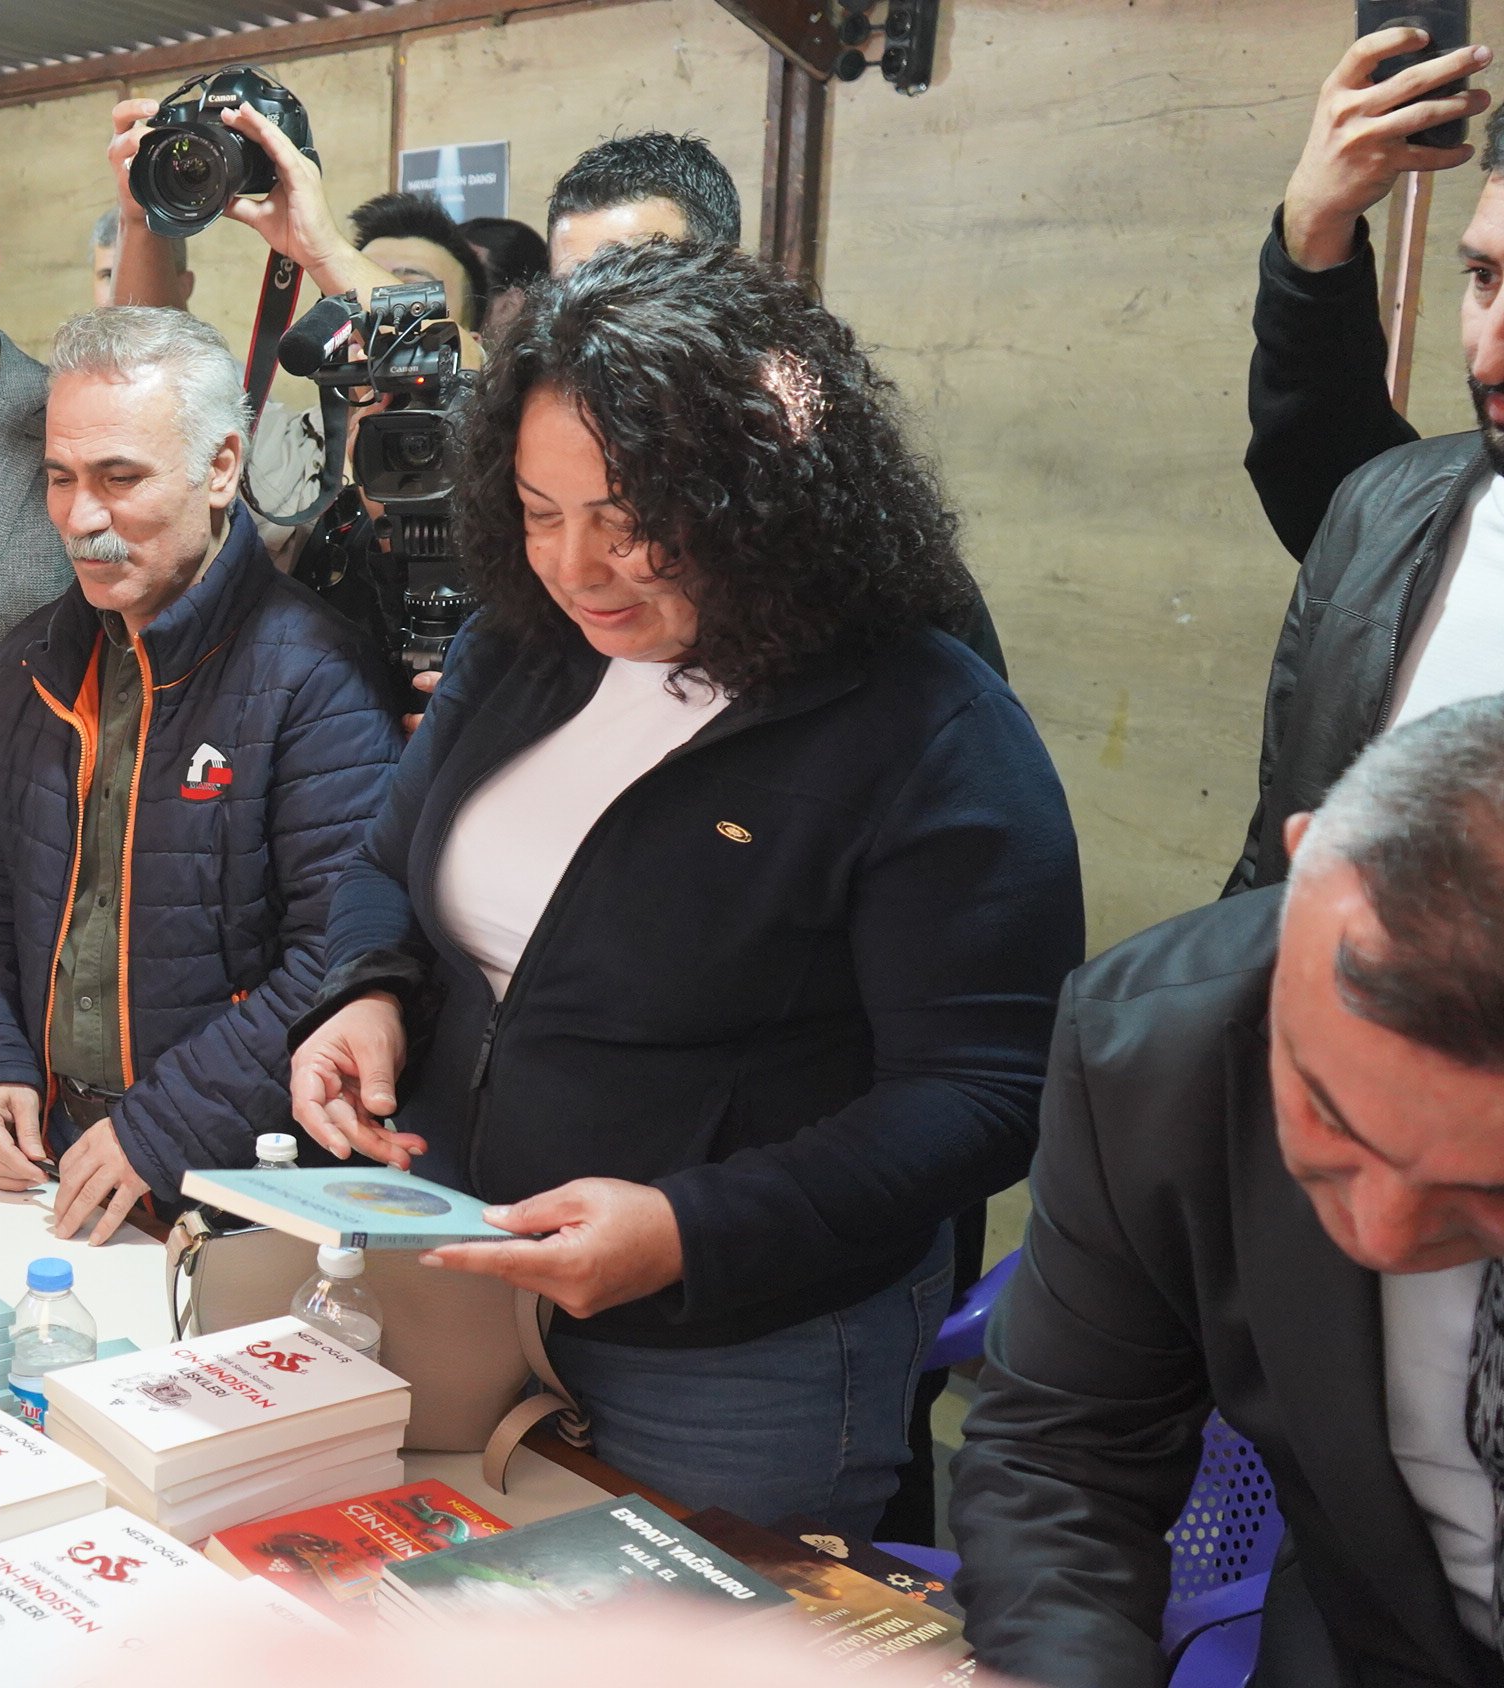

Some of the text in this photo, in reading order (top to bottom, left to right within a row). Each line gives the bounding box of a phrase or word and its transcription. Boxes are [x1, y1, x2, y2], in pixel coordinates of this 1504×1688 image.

[208, 94, 237, 102] Canon
[390, 365, 419, 374] Canon
[610, 1506, 757, 1601] EMPATİ YAĞMURU
[619, 1542, 679, 1583] HALİL EL
[870, 1617, 914, 1638] YARALI
[880, 1621, 948, 1655] MUKADDES
